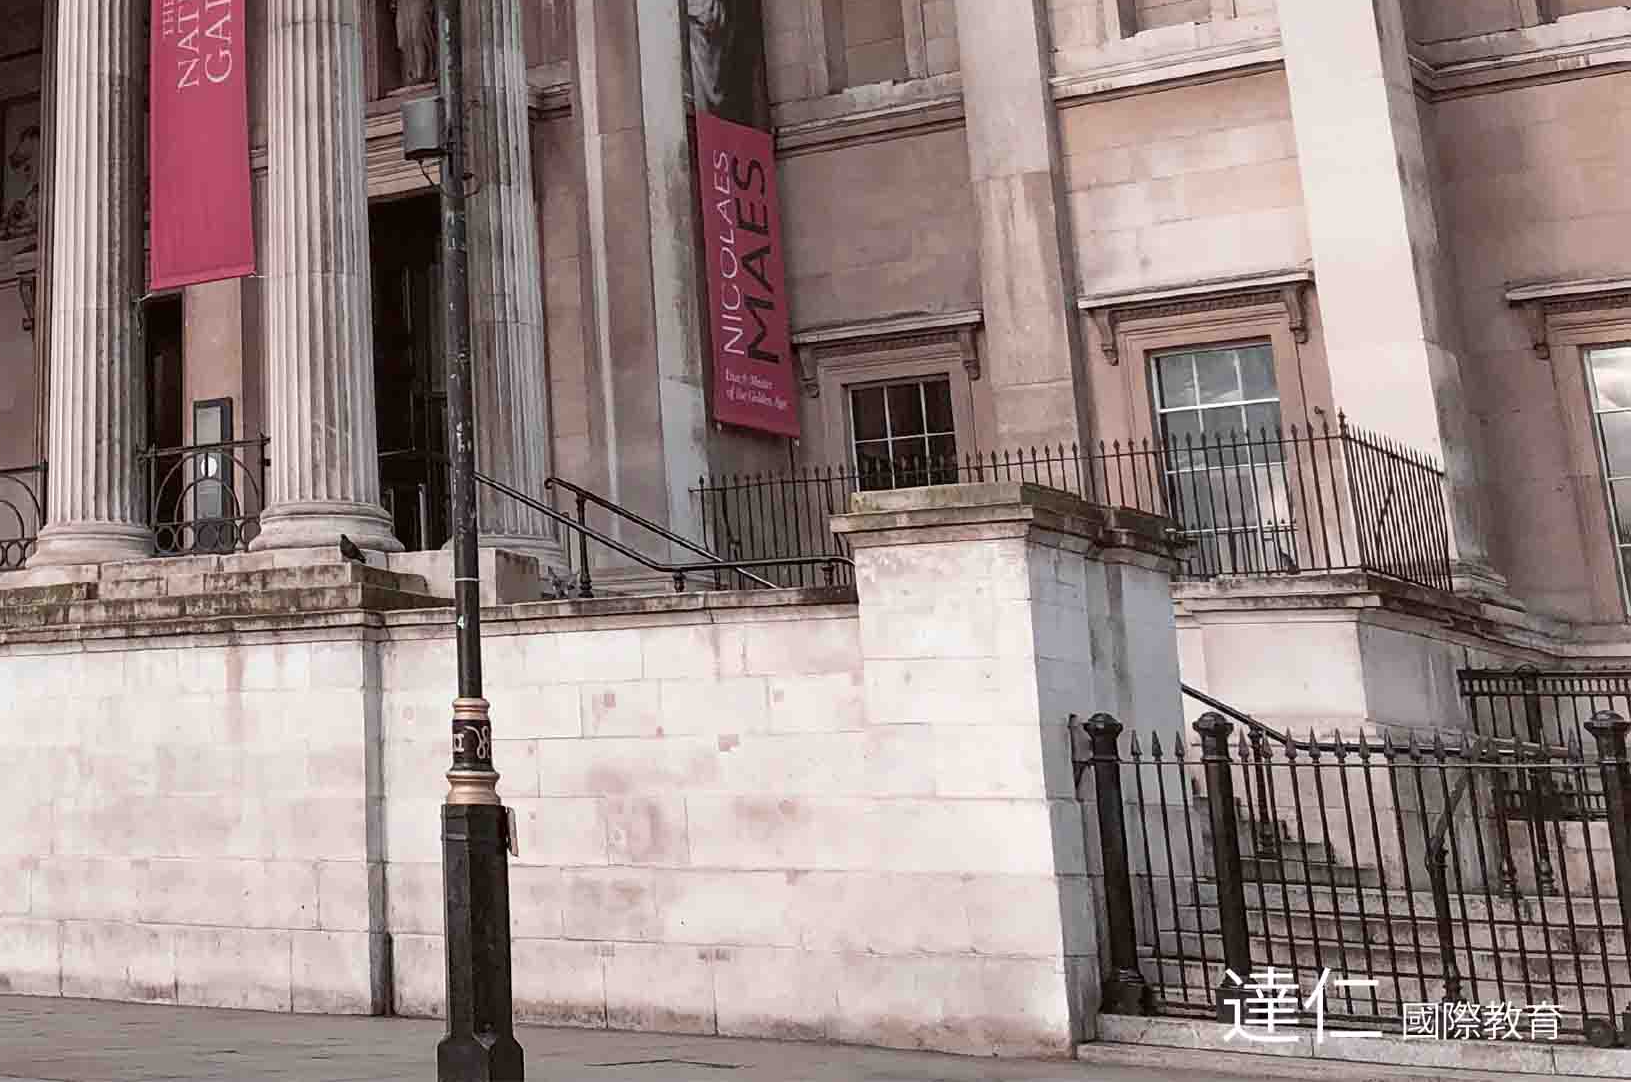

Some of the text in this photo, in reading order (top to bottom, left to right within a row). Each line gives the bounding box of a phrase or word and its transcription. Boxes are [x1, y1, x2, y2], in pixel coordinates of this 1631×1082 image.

[713, 150, 745, 356] NICOLAES
[733, 157, 780, 364] MAES
[457, 614, 465, 629] 4
